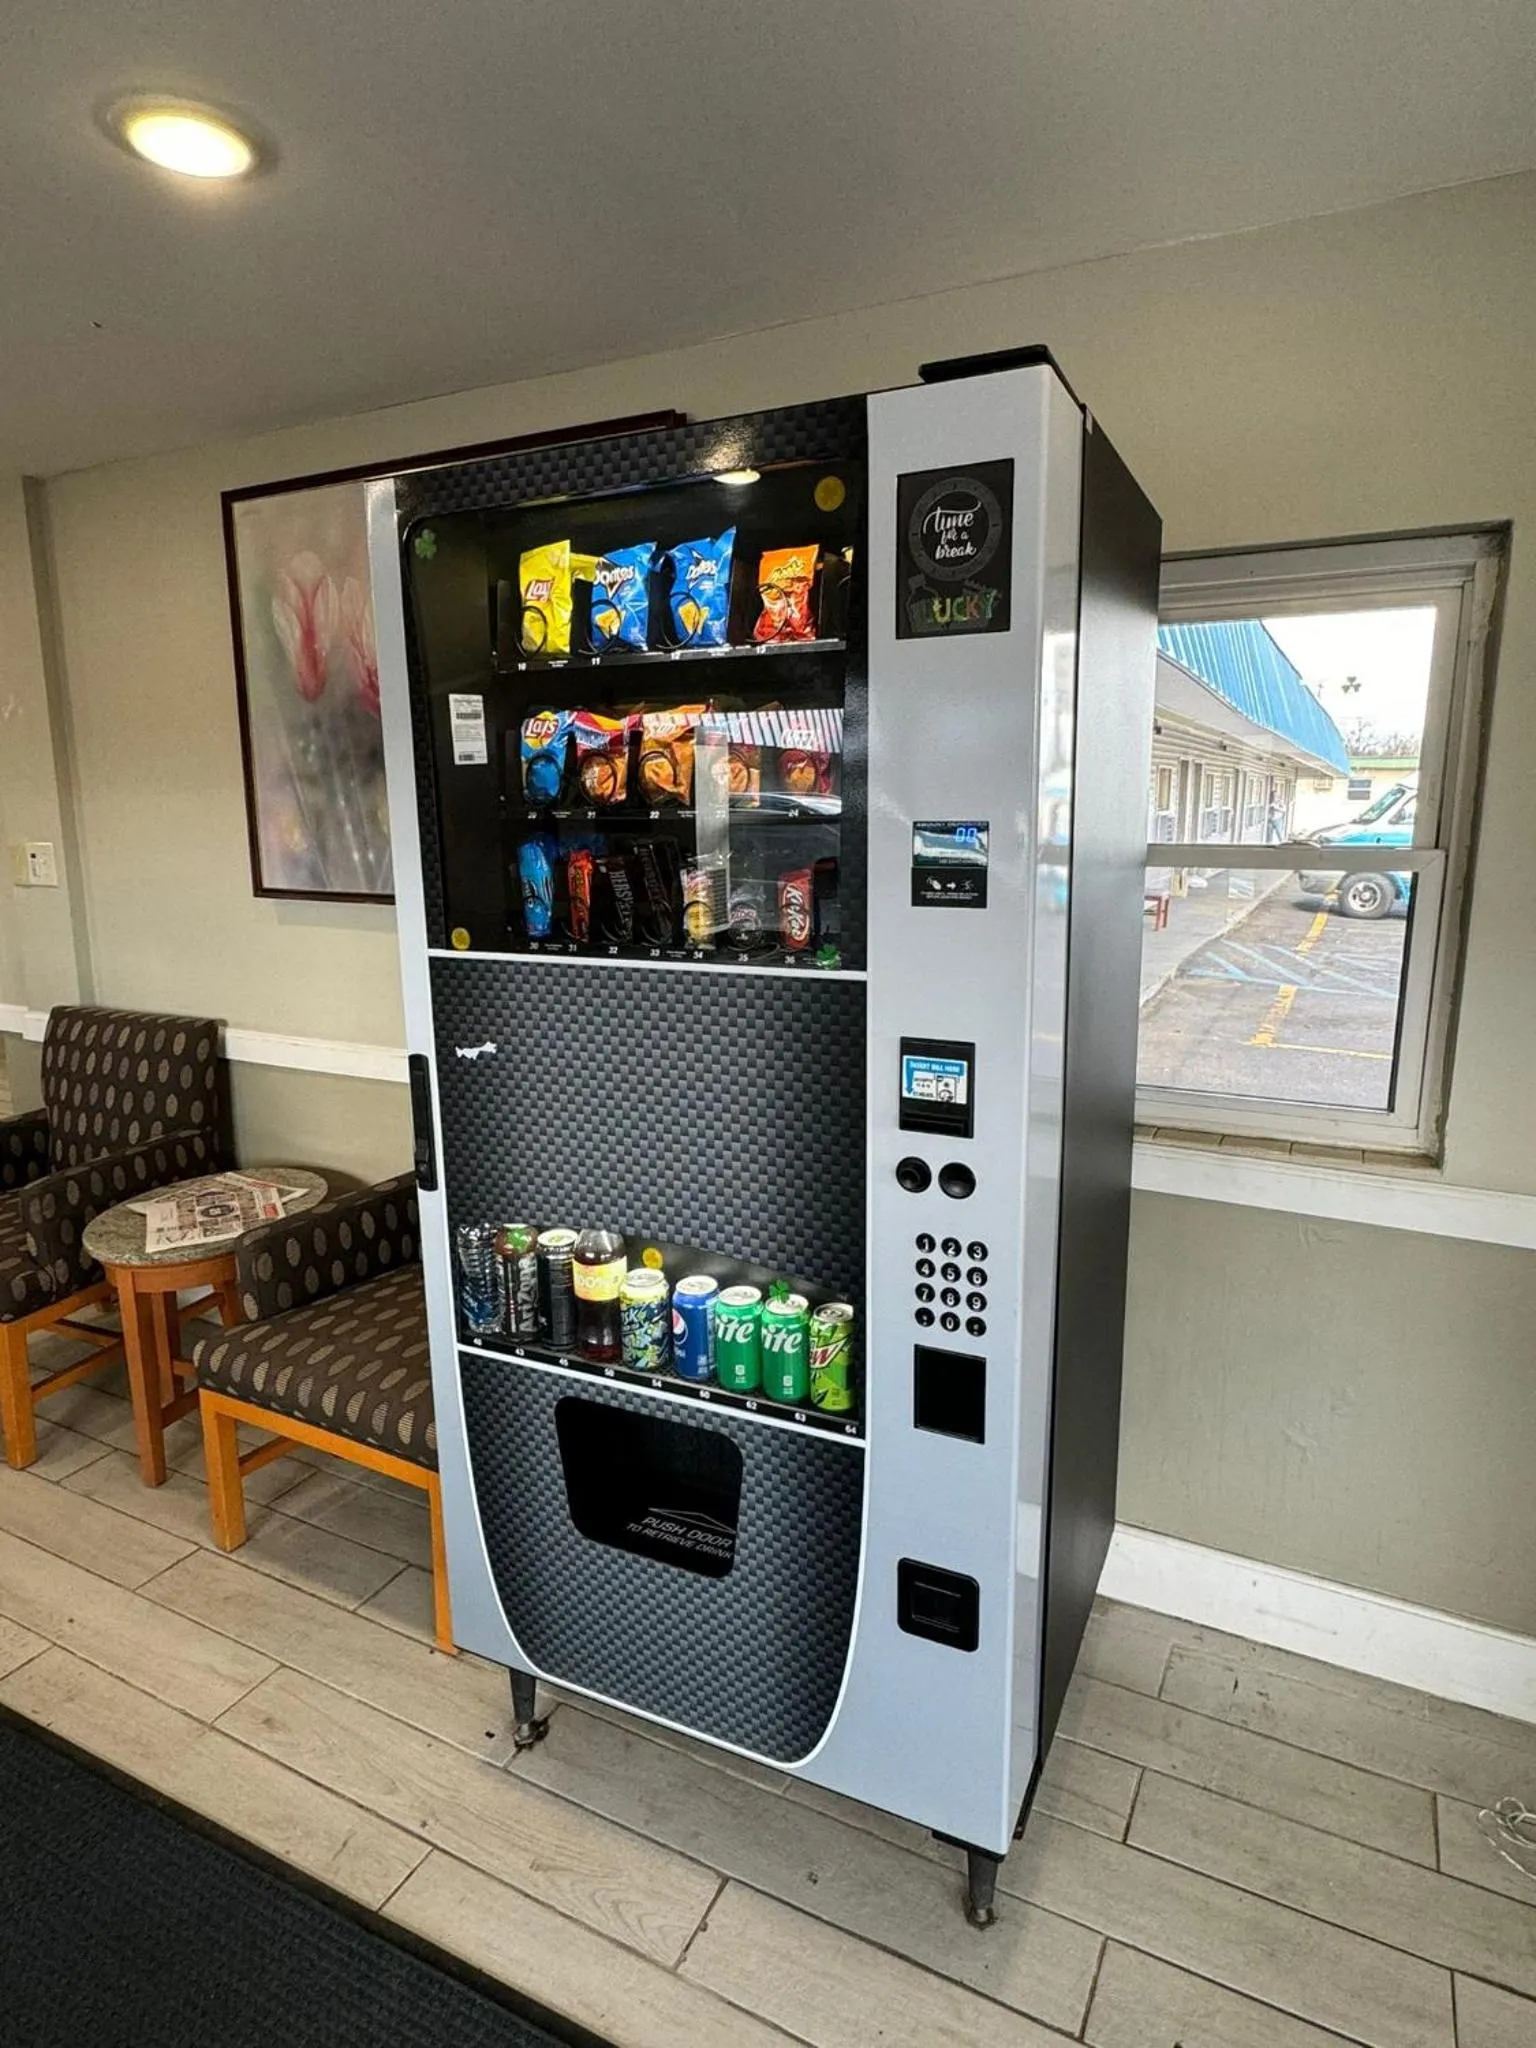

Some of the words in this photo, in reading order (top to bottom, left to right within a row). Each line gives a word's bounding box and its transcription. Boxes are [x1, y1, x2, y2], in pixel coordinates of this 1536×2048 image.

[926, 503, 978, 533] time
[961, 531, 970, 541] a
[935, 542, 978, 560] break
[626, 1523, 643, 1533] TO
[641, 1528, 697, 1548] RETRIEVE
[641, 1517, 687, 1535] PUSH
[687, 1529, 733, 1548] DOOR
